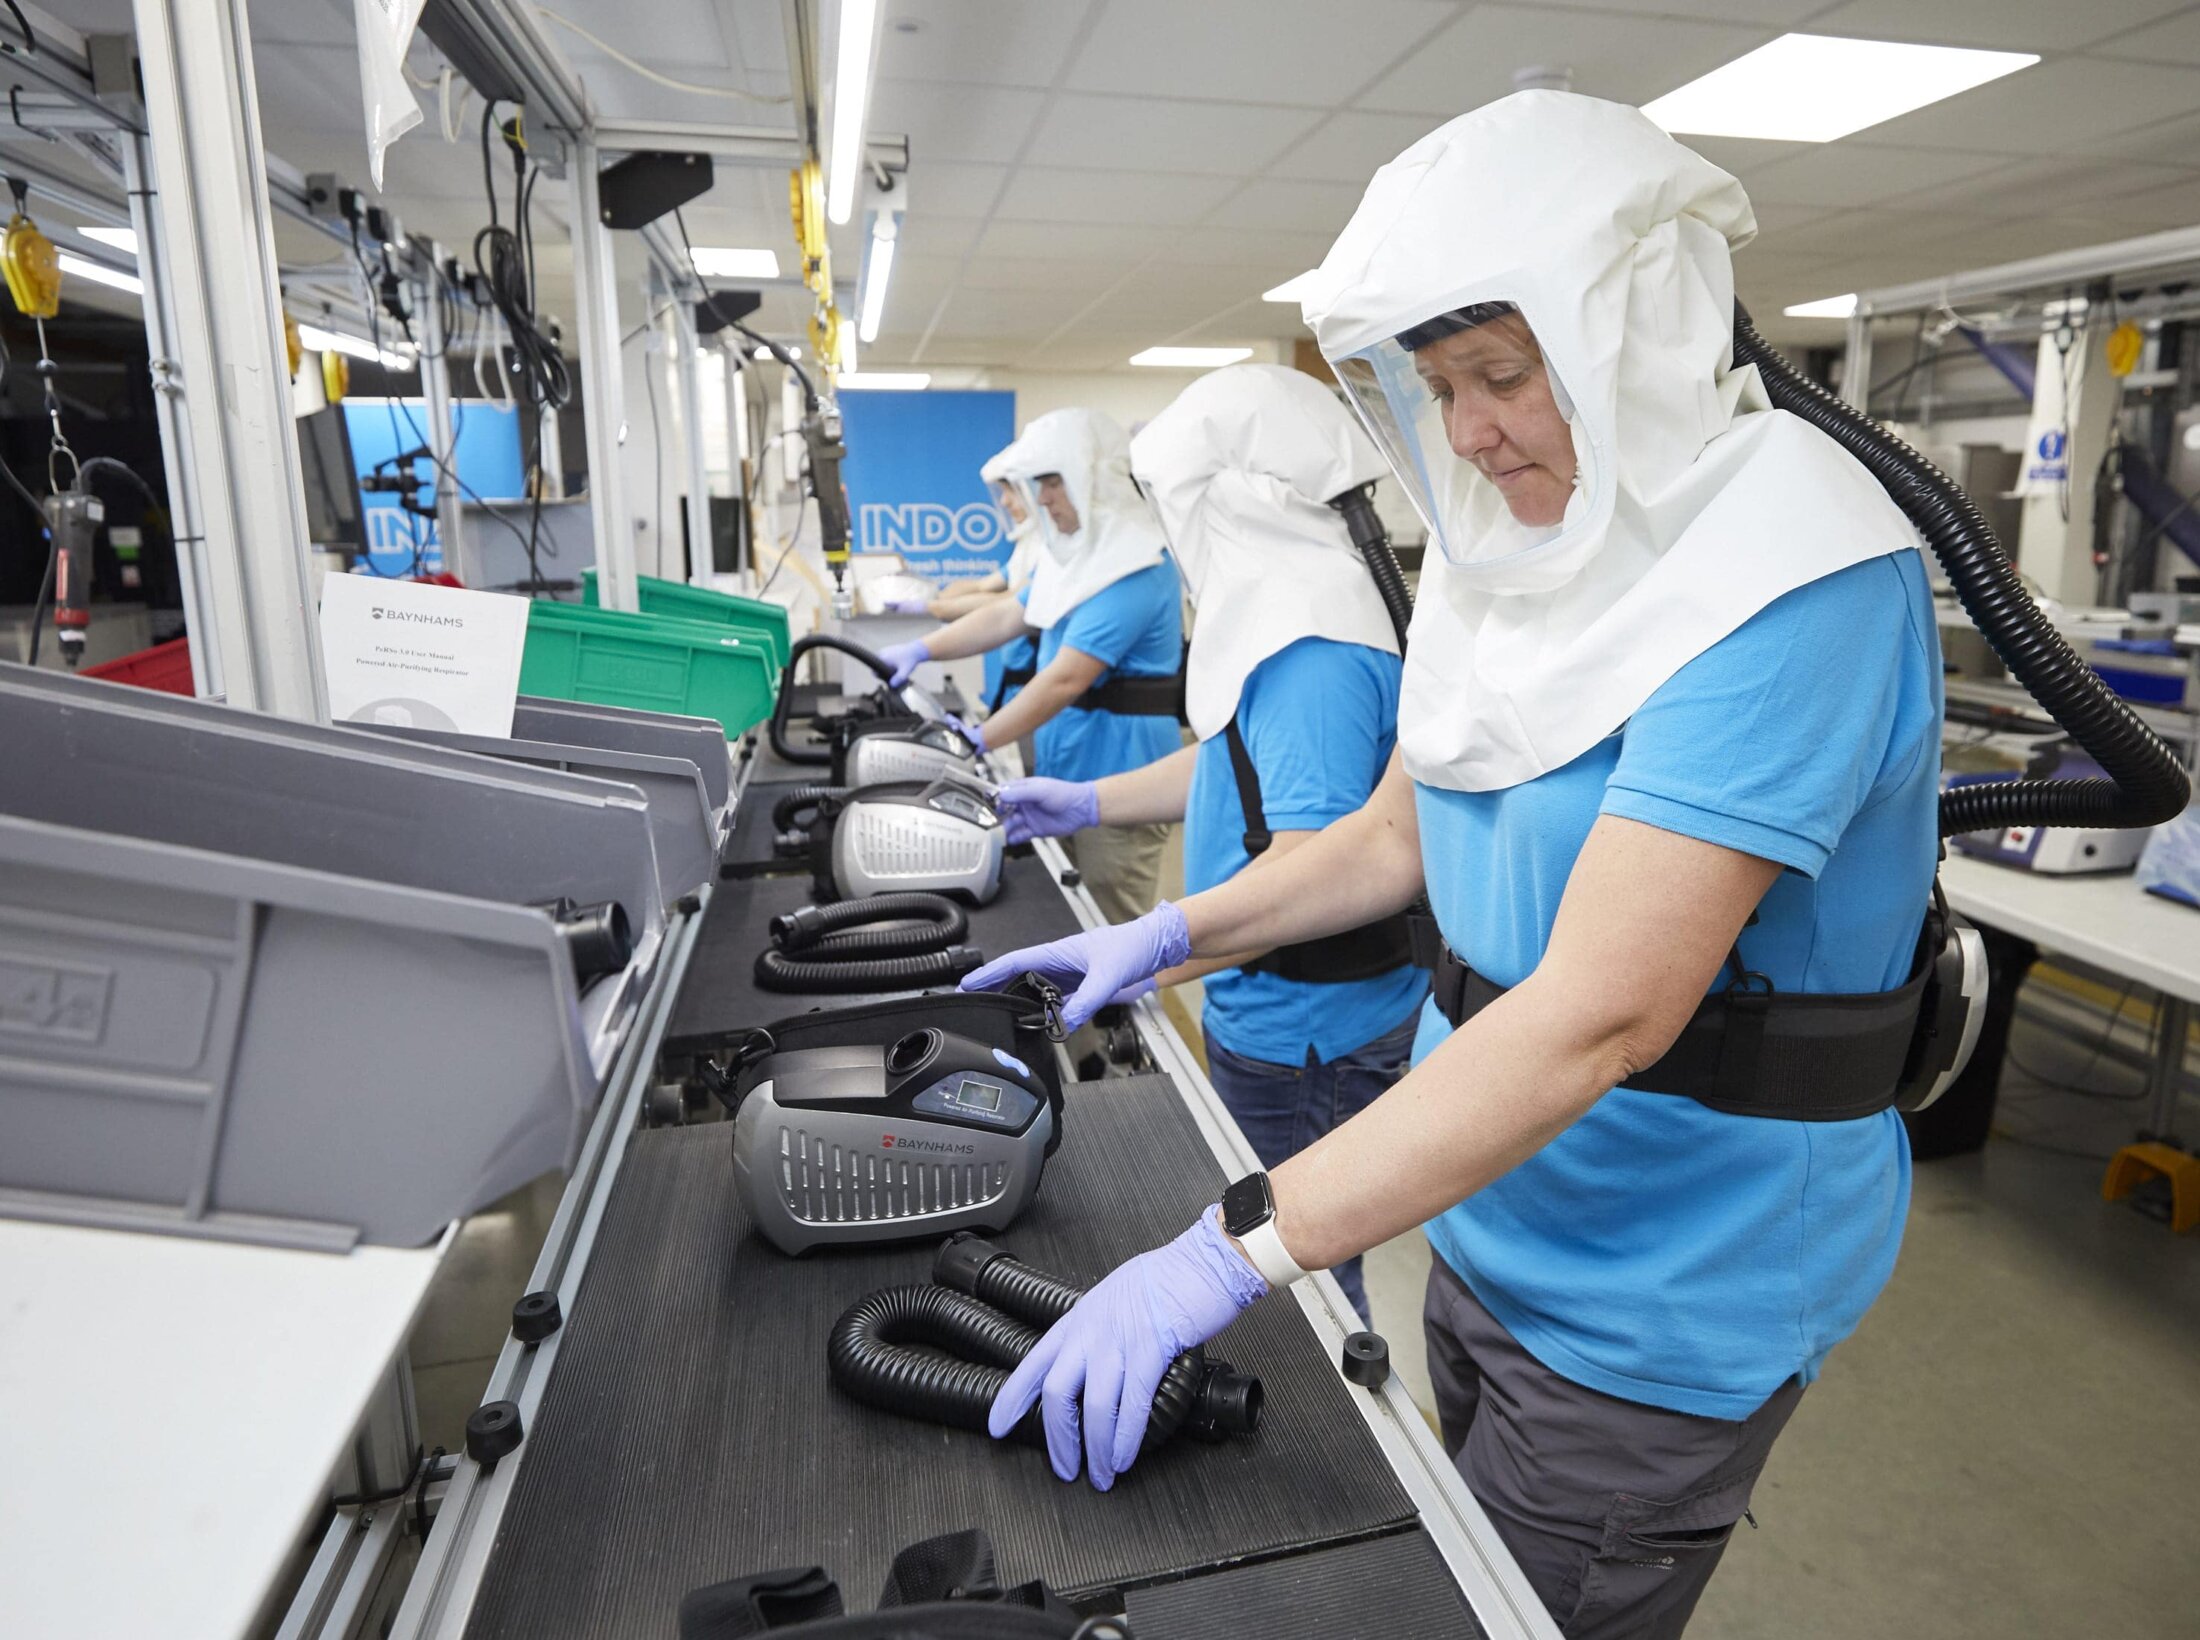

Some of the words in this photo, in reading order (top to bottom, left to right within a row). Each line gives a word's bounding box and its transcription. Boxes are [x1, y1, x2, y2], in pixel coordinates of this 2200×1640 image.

[366, 507, 442, 554] IN
[860, 503, 1001, 552] INDO
[387, 609, 464, 628] BAYNHAMS
[411, 650, 426, 658] User
[428, 652, 455, 660] Manual
[356, 658, 386, 667] Powered
[388, 662, 432, 673] Air-Purifying
[434, 667, 470, 677] Respirator
[897, 1138, 975, 1154] BAYNHAMS
